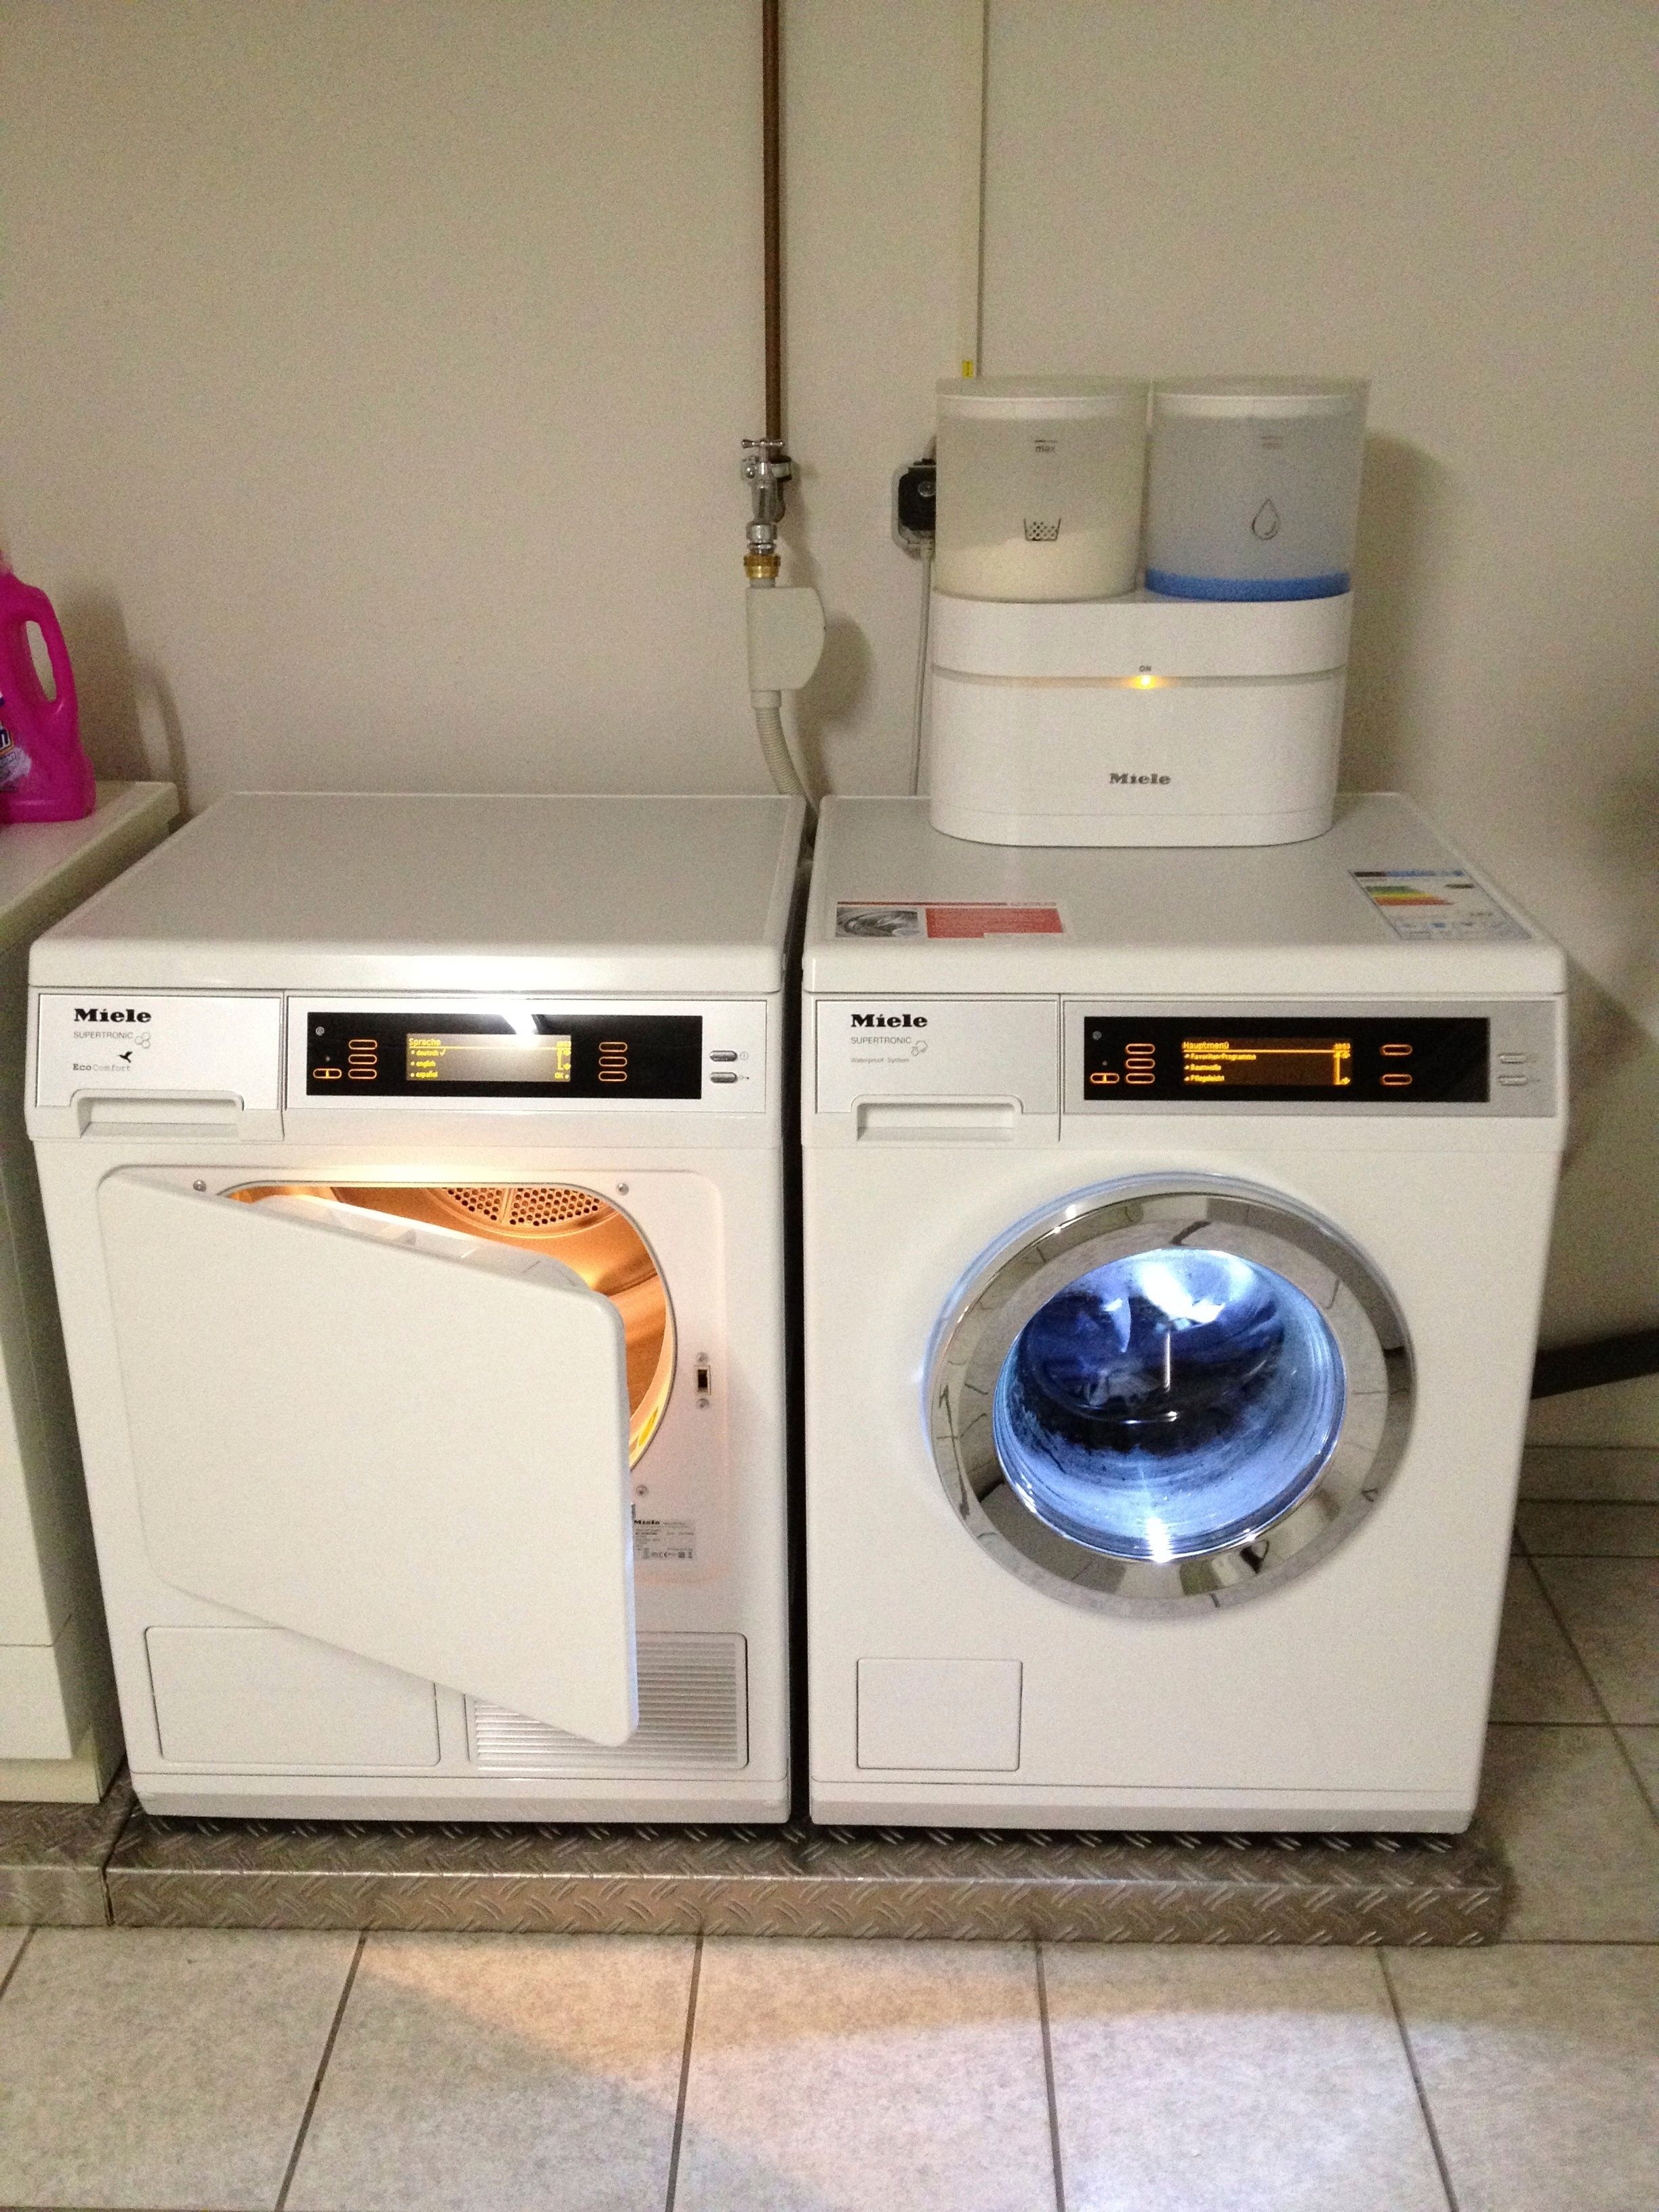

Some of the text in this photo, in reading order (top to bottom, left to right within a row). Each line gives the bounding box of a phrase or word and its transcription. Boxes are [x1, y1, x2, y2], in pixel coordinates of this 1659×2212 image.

[1109, 772, 1171, 785] Miele
[73, 1007, 152, 1023] Miele
[851, 1013, 928, 1027] Miele
[73, 1031, 134, 1039] SUPERTRONIC
[851, 1036, 912, 1044] SUPERTRONIC
